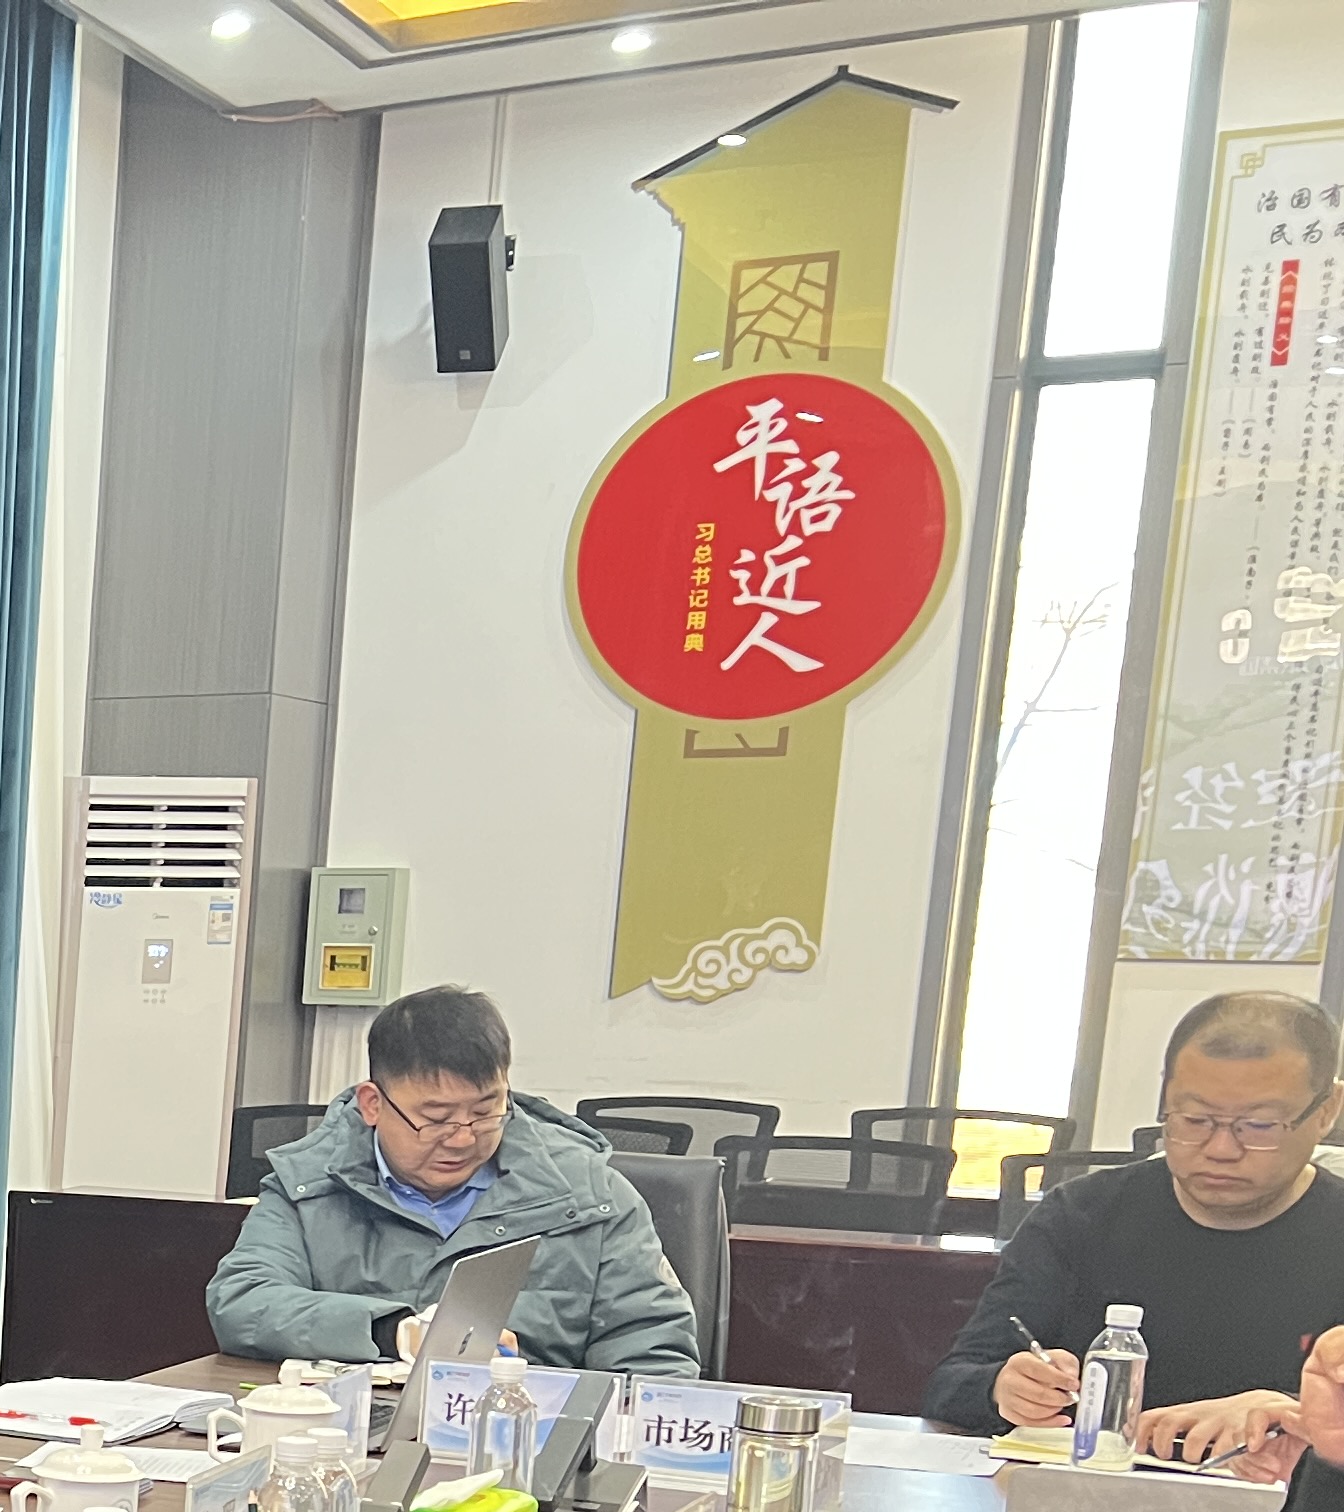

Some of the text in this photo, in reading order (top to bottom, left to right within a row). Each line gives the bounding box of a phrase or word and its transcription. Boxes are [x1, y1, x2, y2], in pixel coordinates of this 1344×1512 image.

[684, 522, 715, 653] 习总书记用典
[714, 398, 856, 673] 平语近人
